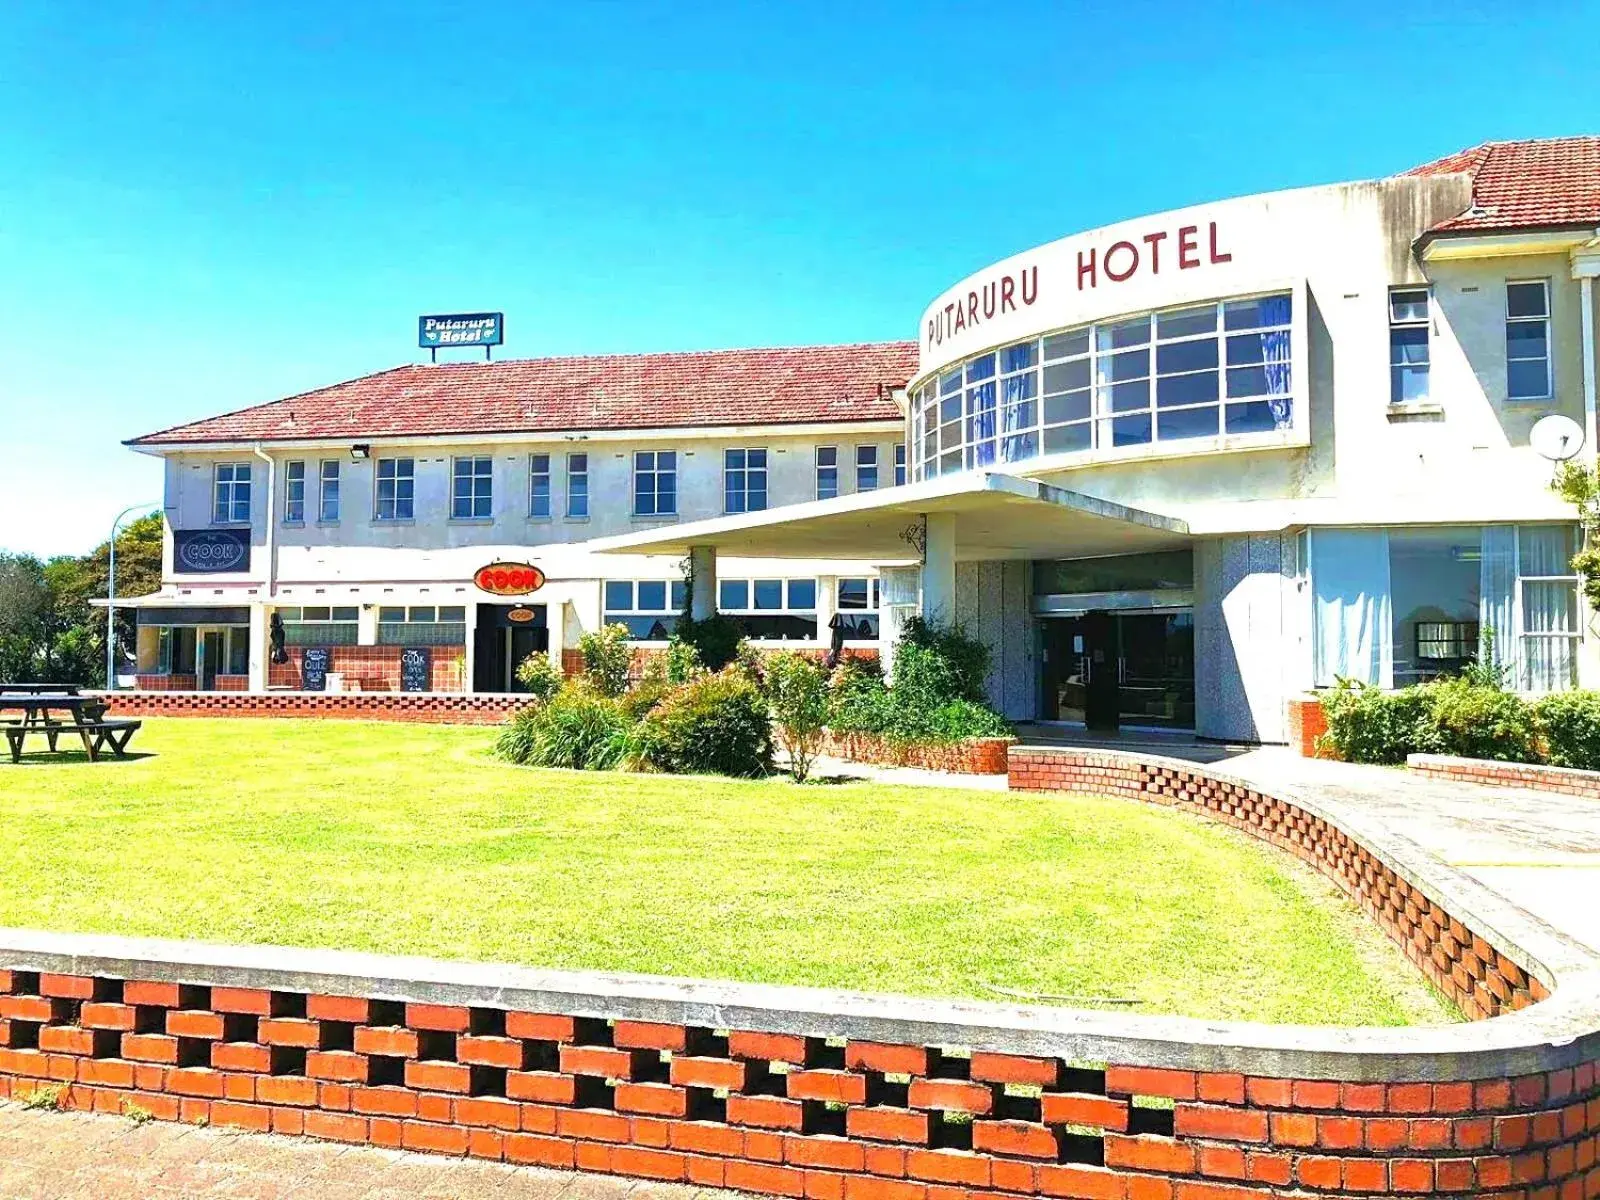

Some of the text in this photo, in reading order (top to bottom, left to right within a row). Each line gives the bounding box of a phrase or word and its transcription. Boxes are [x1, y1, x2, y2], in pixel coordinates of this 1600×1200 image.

[928, 221, 1232, 352] PUTARURU HOTEL
[425, 318, 495, 331] Putaruru
[439, 329, 481, 342] Hotel
[188, 543, 234, 559] COOK
[480, 570, 538, 590] COOK
